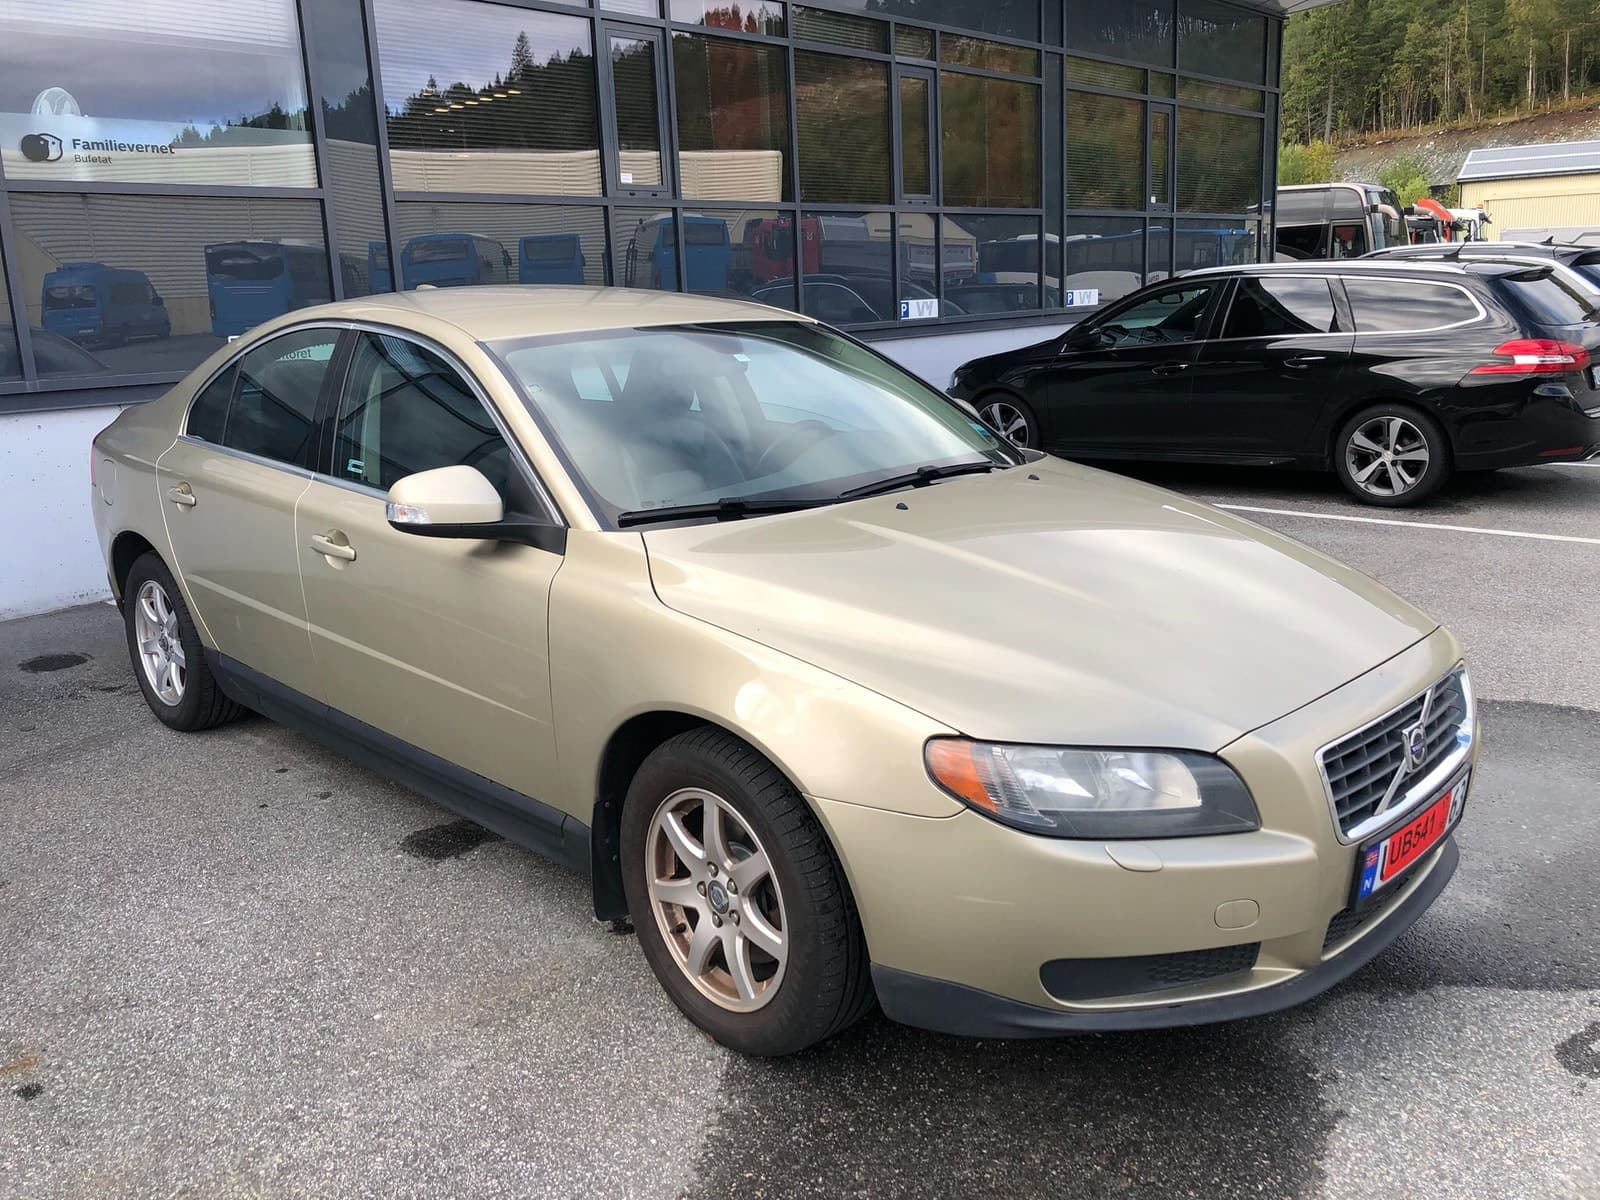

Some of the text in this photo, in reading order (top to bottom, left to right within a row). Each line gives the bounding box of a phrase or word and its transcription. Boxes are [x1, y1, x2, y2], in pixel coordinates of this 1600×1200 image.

[72, 138, 175, 154] Familievernet
[74, 154, 112, 164] Bufetat
[1389, 811, 1436, 865] UB541
[1363, 877, 1372, 891] N
